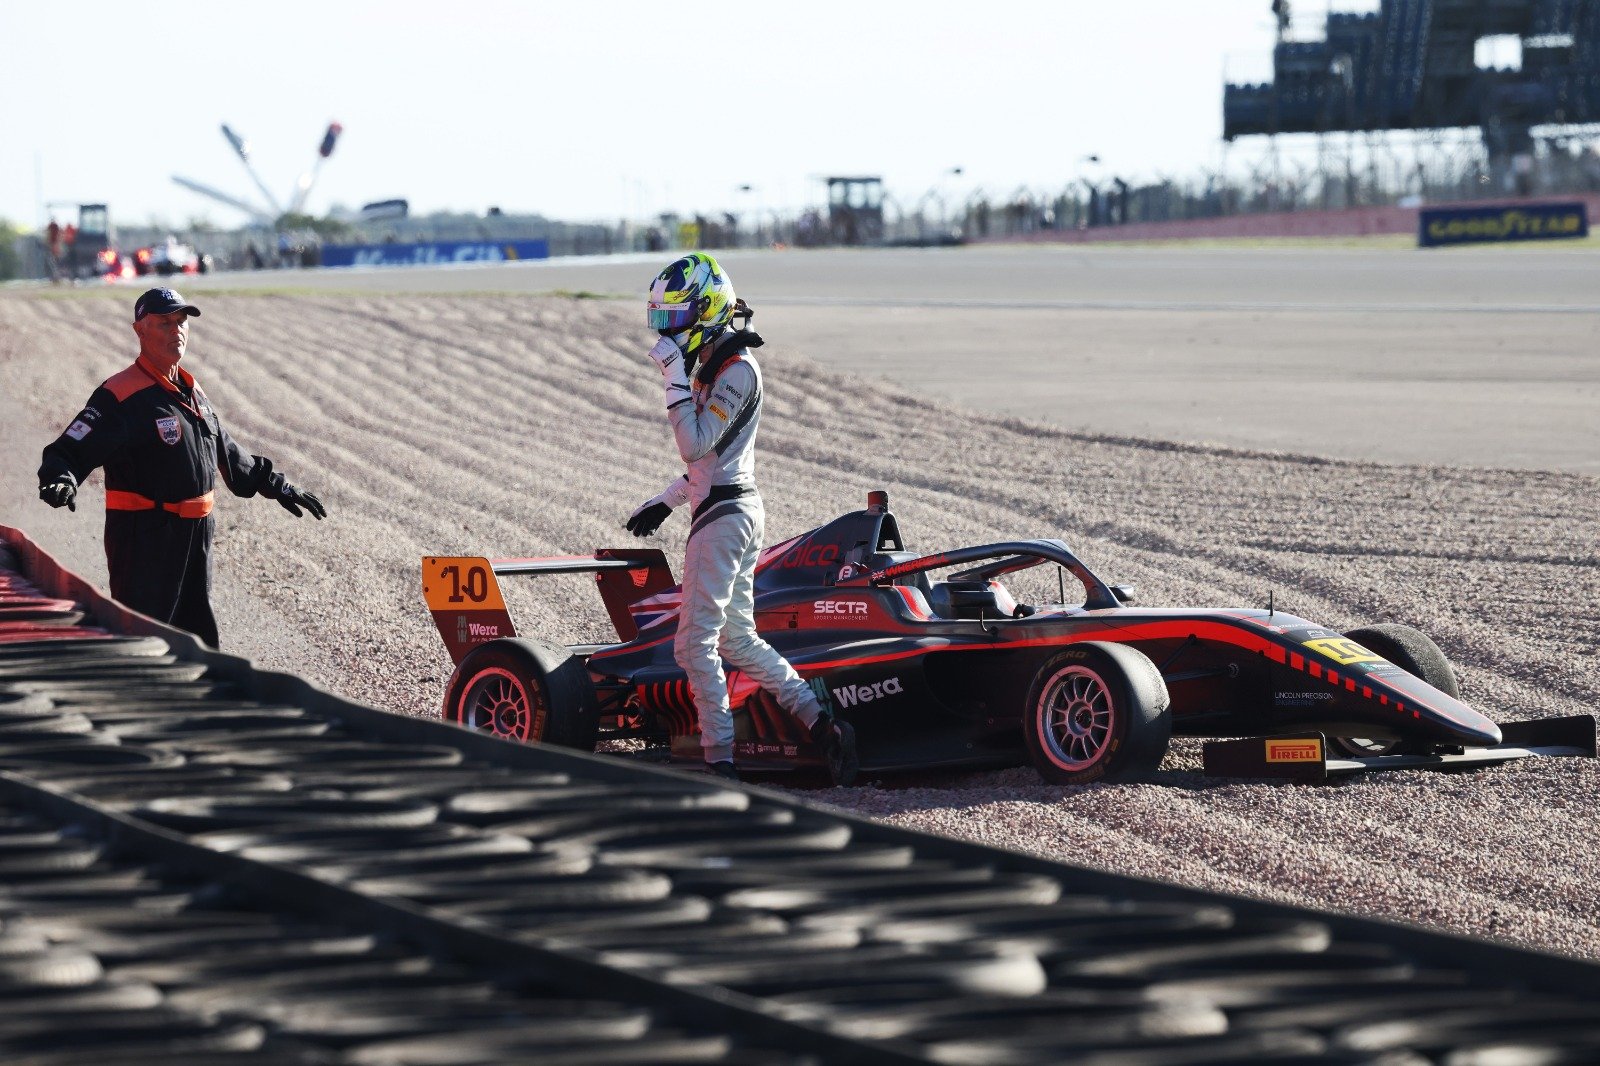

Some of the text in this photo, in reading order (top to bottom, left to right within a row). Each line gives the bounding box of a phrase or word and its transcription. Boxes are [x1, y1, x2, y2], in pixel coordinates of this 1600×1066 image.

[1428, 212, 1580, 239] GOODYEAR
[725, 384, 742, 399] Wera
[441, 566, 487, 602] 10
[814, 601, 868, 614] SECTR
[469, 623, 498, 636] Wera
[1317, 641, 1377, 660] 10
[832, 677, 904, 709] Wera
[1274, 691, 1334, 700] LINCOLN PRECISION
[1270, 745, 1317, 760] PIRELLI
